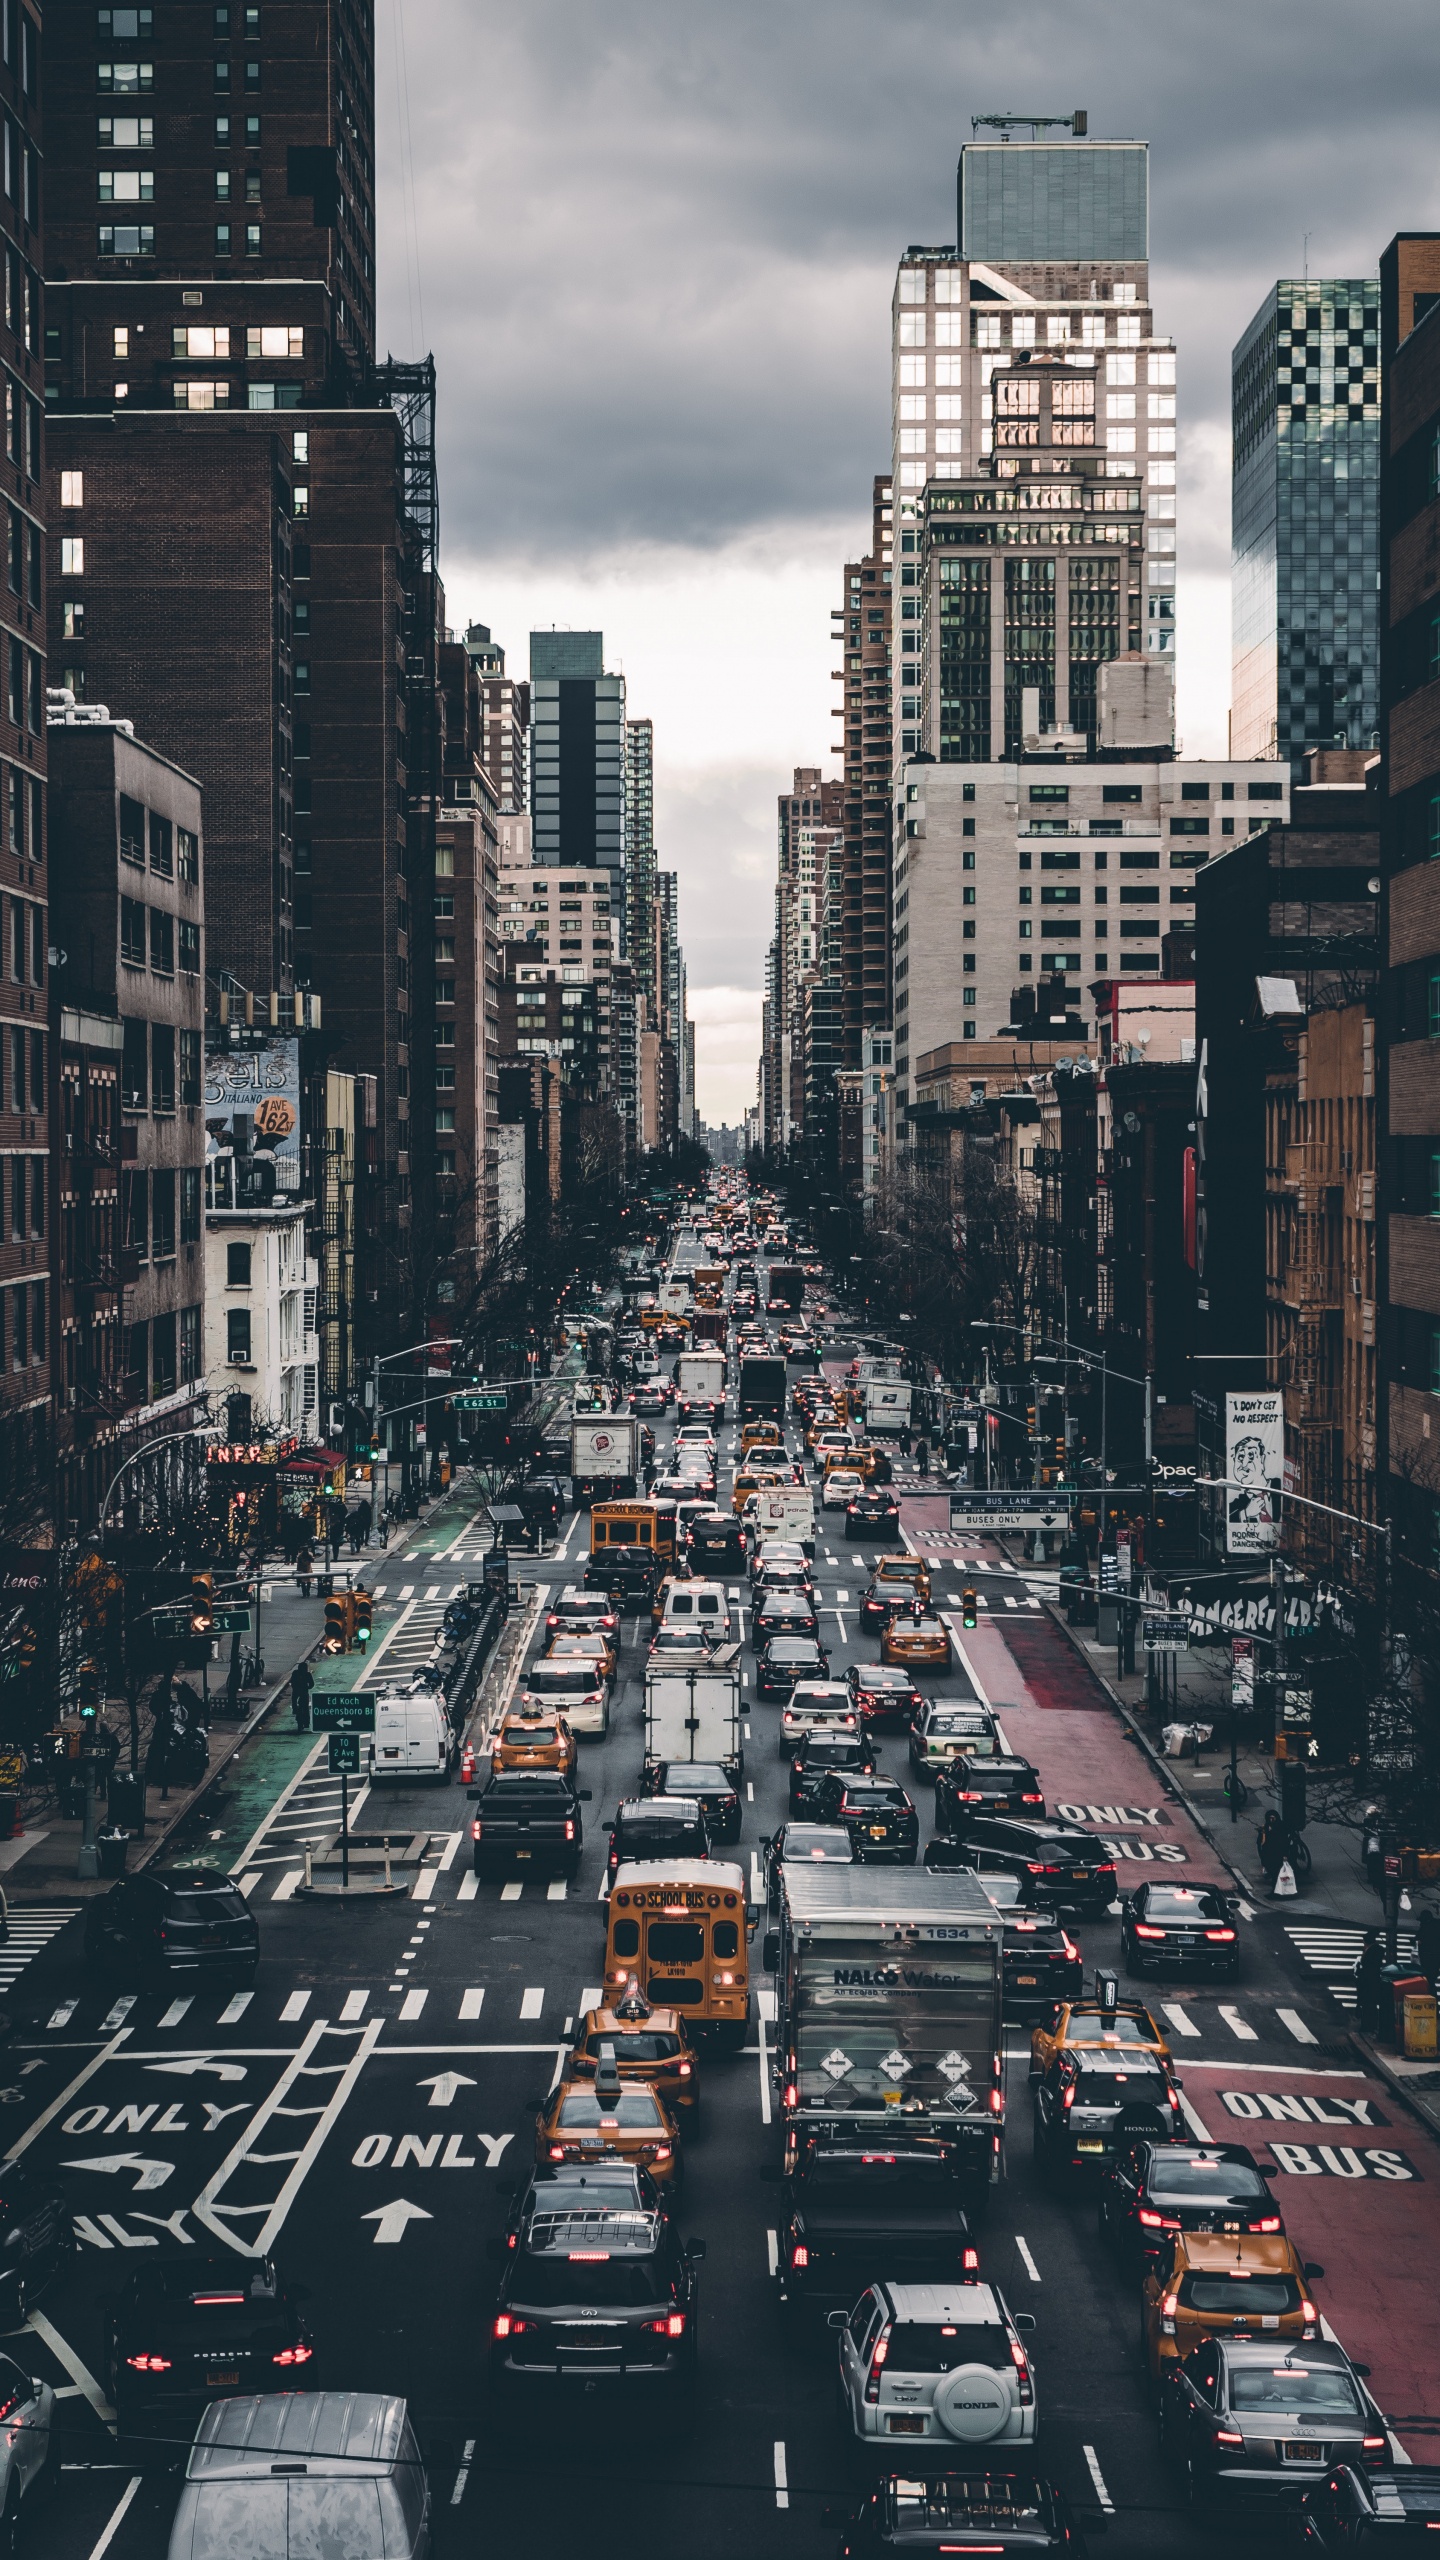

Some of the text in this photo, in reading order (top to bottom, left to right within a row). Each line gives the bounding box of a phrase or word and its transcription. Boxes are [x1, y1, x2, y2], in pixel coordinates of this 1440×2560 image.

[224, 1094, 262, 1104] ITALIANO
[260, 1100, 288, 1124] 1 AVE
[266, 1112, 289, 1132] 62
[464, 1400, 470, 1408] E
[1240, 1399, 1262, 1412] DON'T
[1264, 1400, 1276, 1410] GET
[1232, 1414, 1246, 1424] NO
[1177, 1592, 1324, 1636] DANGERFILD'S
[213, 1618, 230, 1630] St
[1058, 1804, 1162, 1825] ONLY
[1100, 1841, 1186, 1862] BUS
[648, 1892, 704, 1907] SCHOOL BUS
[927, 1929, 970, 1939] 1634
[834, 1970, 961, 1987] NALCO Water
[881, 1989, 922, 1998] Company
[1222, 2092, 1374, 2125] ONLY
[61, 2103, 254, 2133] ONLY
[351, 2134, 516, 2167] ONLY
[1269, 2143, 1412, 2180] BUS
